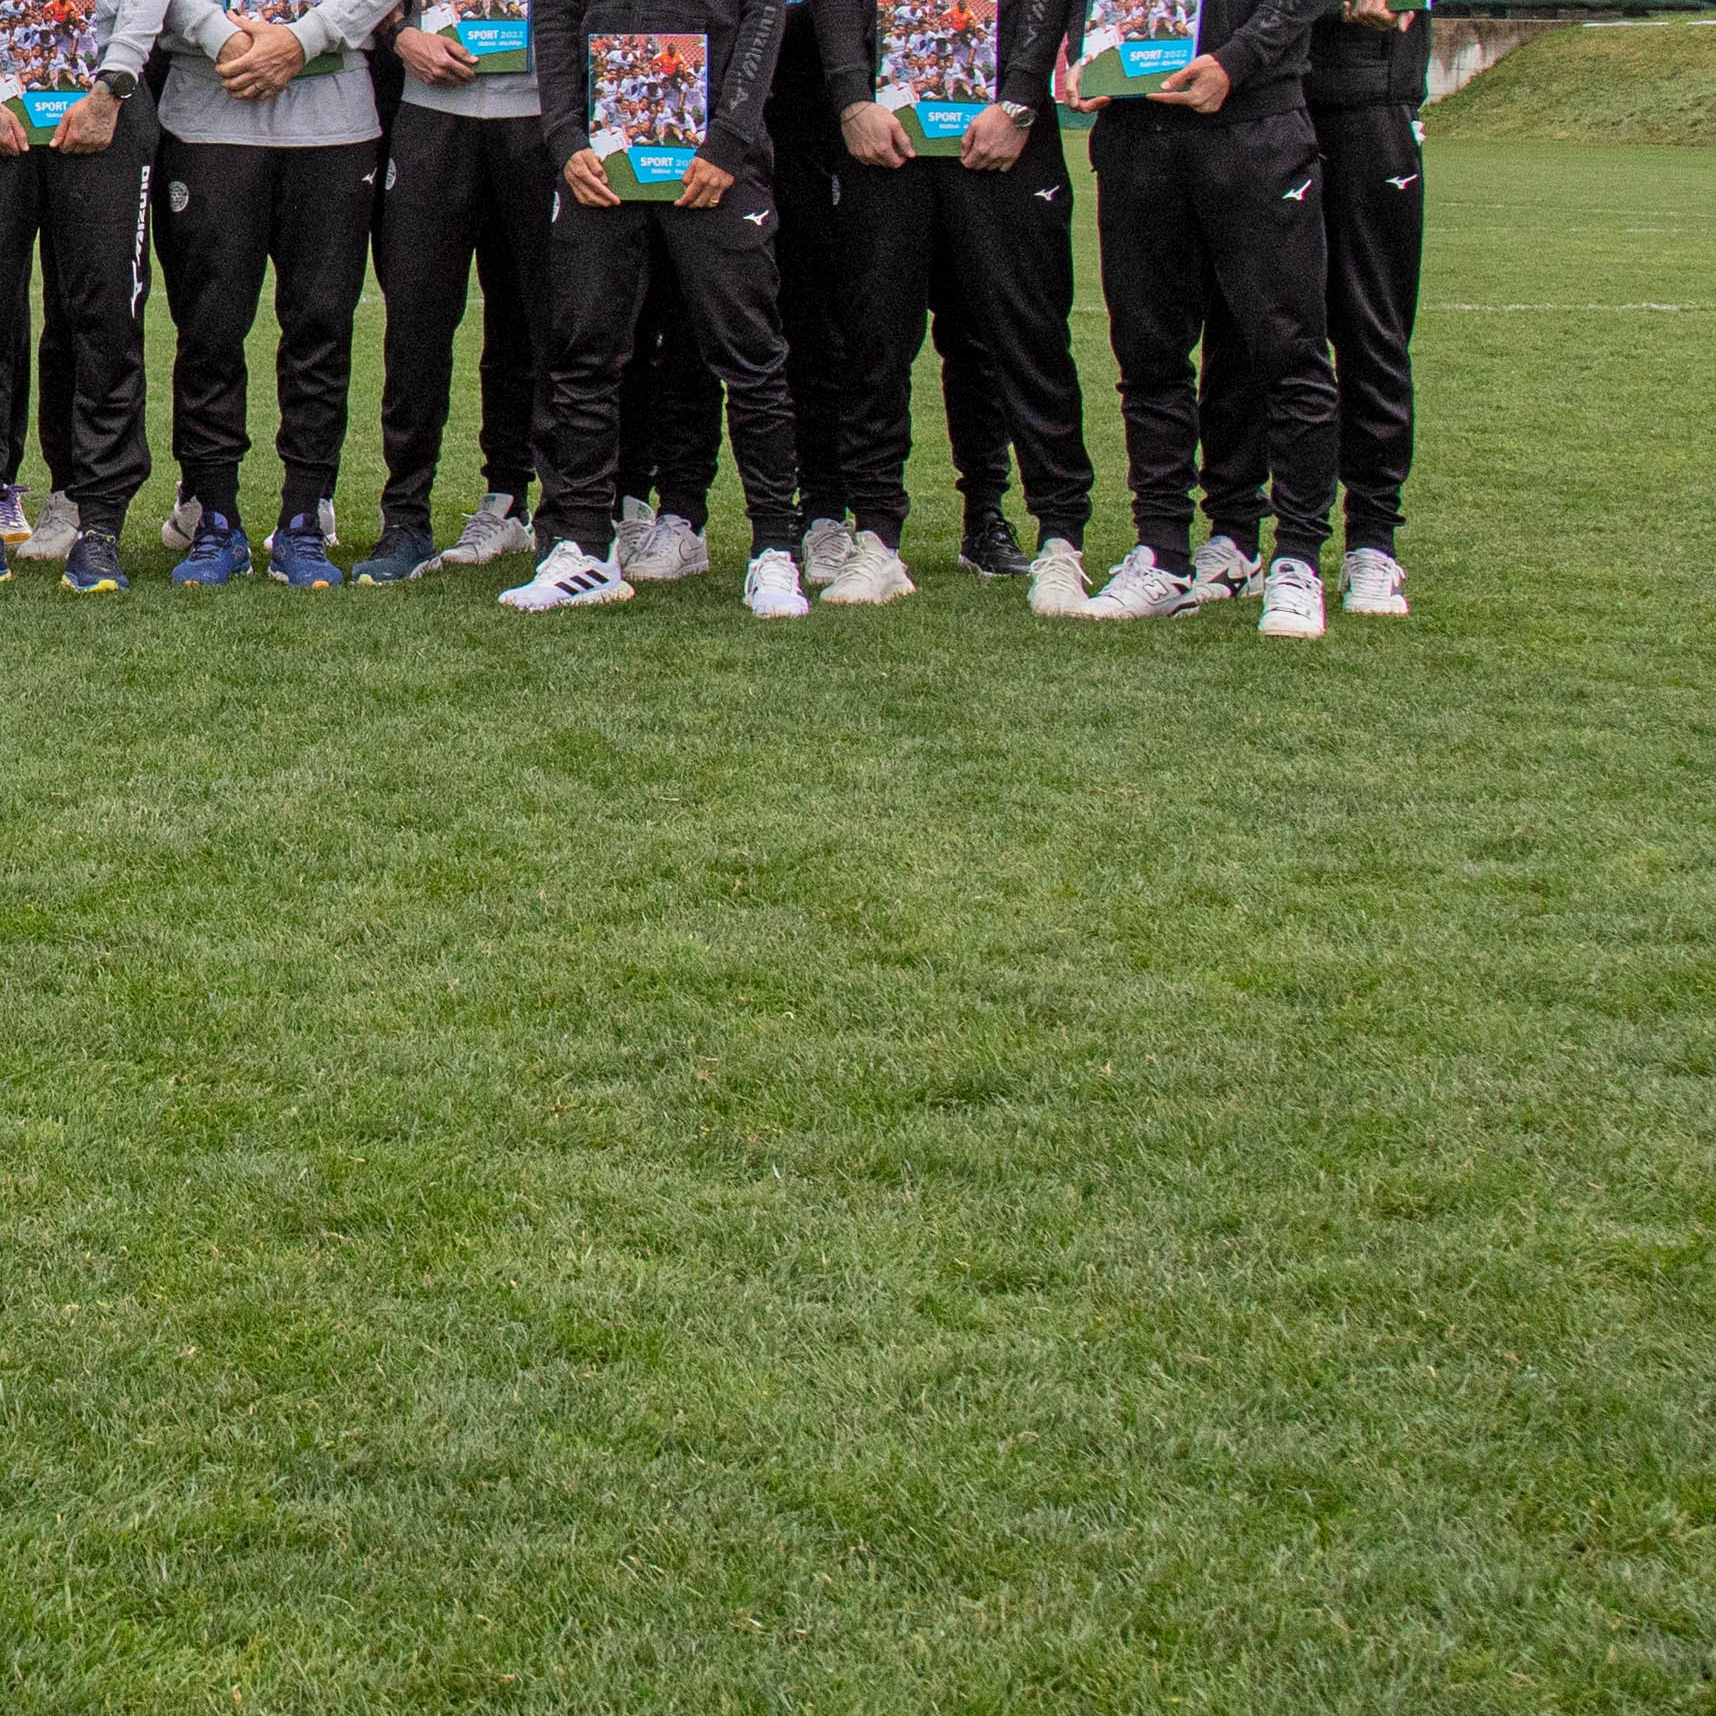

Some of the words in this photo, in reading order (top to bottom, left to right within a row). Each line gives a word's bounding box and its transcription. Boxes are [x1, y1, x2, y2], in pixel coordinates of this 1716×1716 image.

[468, 29, 499, 40] SPORT
[1130, 49, 1163, 62] SPORT
[35, 101, 67, 112] SPORT
[928, 111, 962, 122] SPORT
[640, 156, 673, 167] SPORT
